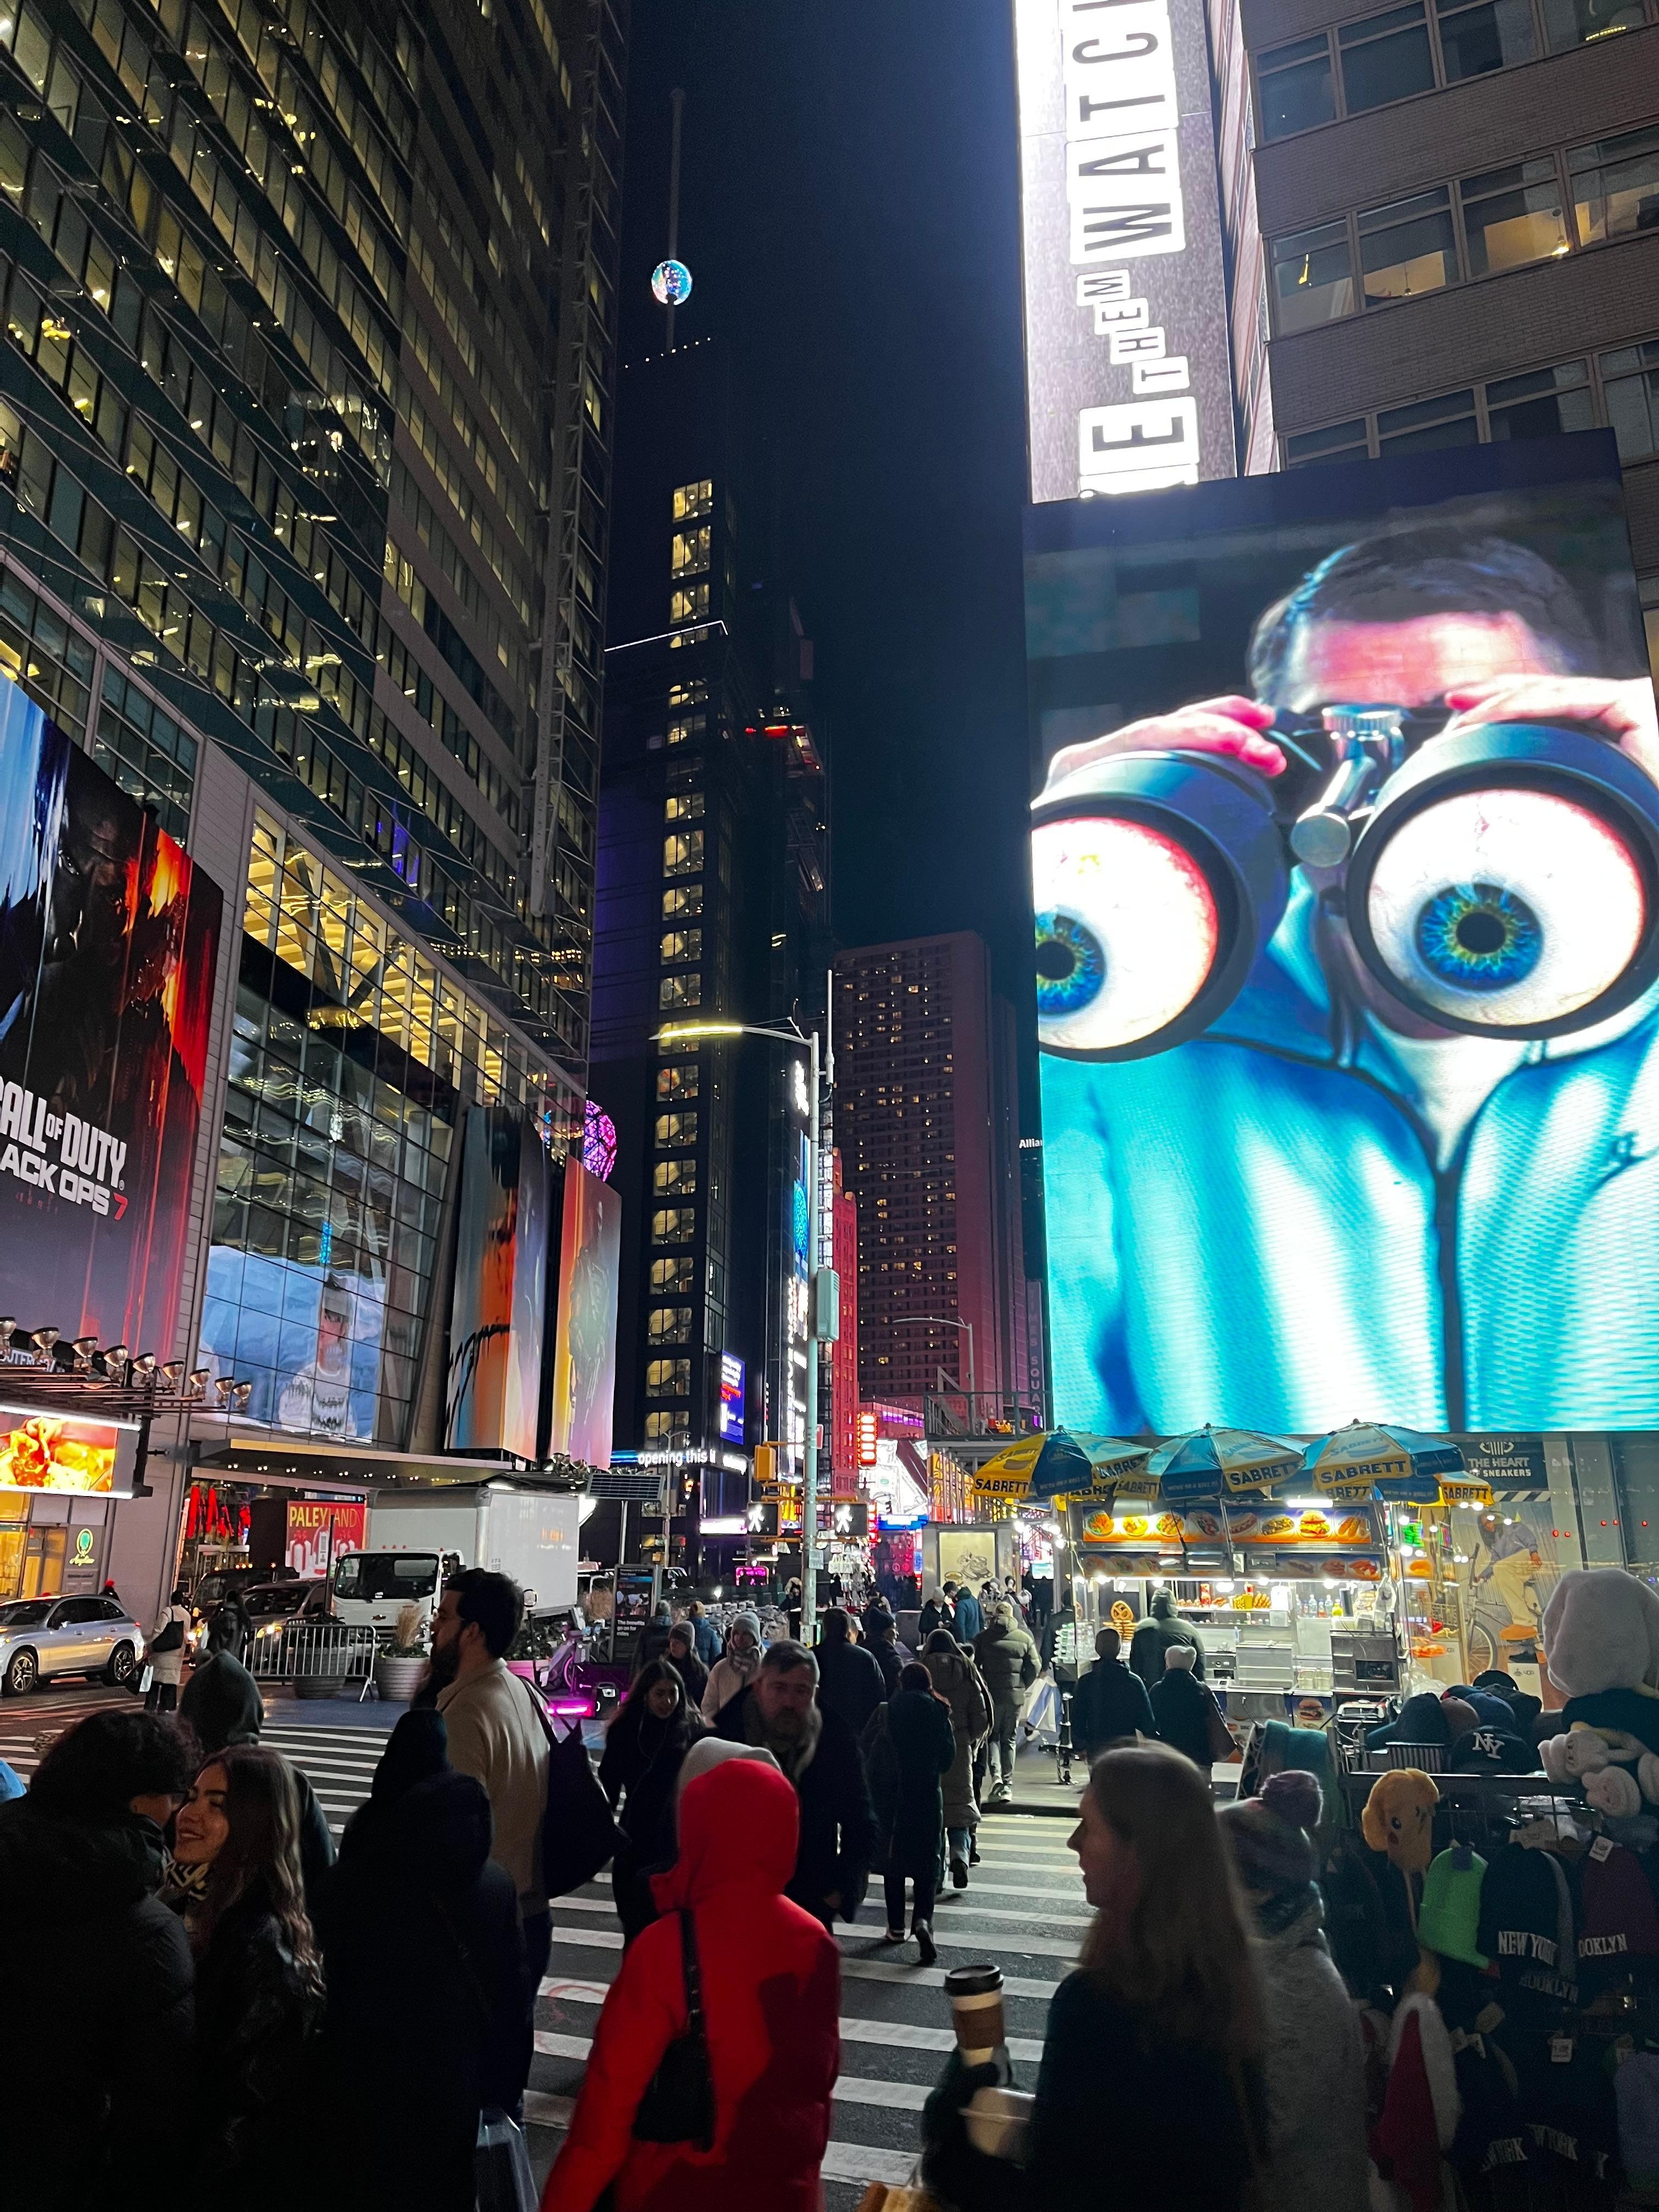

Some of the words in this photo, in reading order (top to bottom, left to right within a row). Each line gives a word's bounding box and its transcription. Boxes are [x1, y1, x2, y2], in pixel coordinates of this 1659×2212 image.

[1084, 278, 1183, 382] THEM
[0, 1076, 47, 1154] ALL
[46, 1113, 64, 1141] OF
[60, 1112, 127, 1189] DUTY
[0, 1143, 59, 1194] ACK
[58, 1169, 110, 1216] OPS
[113, 1193, 128, 1220] 7
[1030, 1356, 1041, 1412] SQUAR
[638, 1449, 683, 1468] opening
[686, 1448, 708, 1464] this
[1468, 1457, 1490, 1468] THE
[1491, 1457, 1530, 1468] HEART
[1320, 1460, 1406, 1483] SABRETT
[1483, 1469, 1532, 1477] SNEAKERS
[974, 1479, 1029, 1494] SABRETT
[1443, 1487, 1488, 1500] SABRETT
[1472, 1732, 1505, 1759] NY
[1497, 1931, 1529, 1956] NEW
[1528, 1933, 1559, 1966] YORK
[1578, 1933, 1628, 1958] OOKLYN
